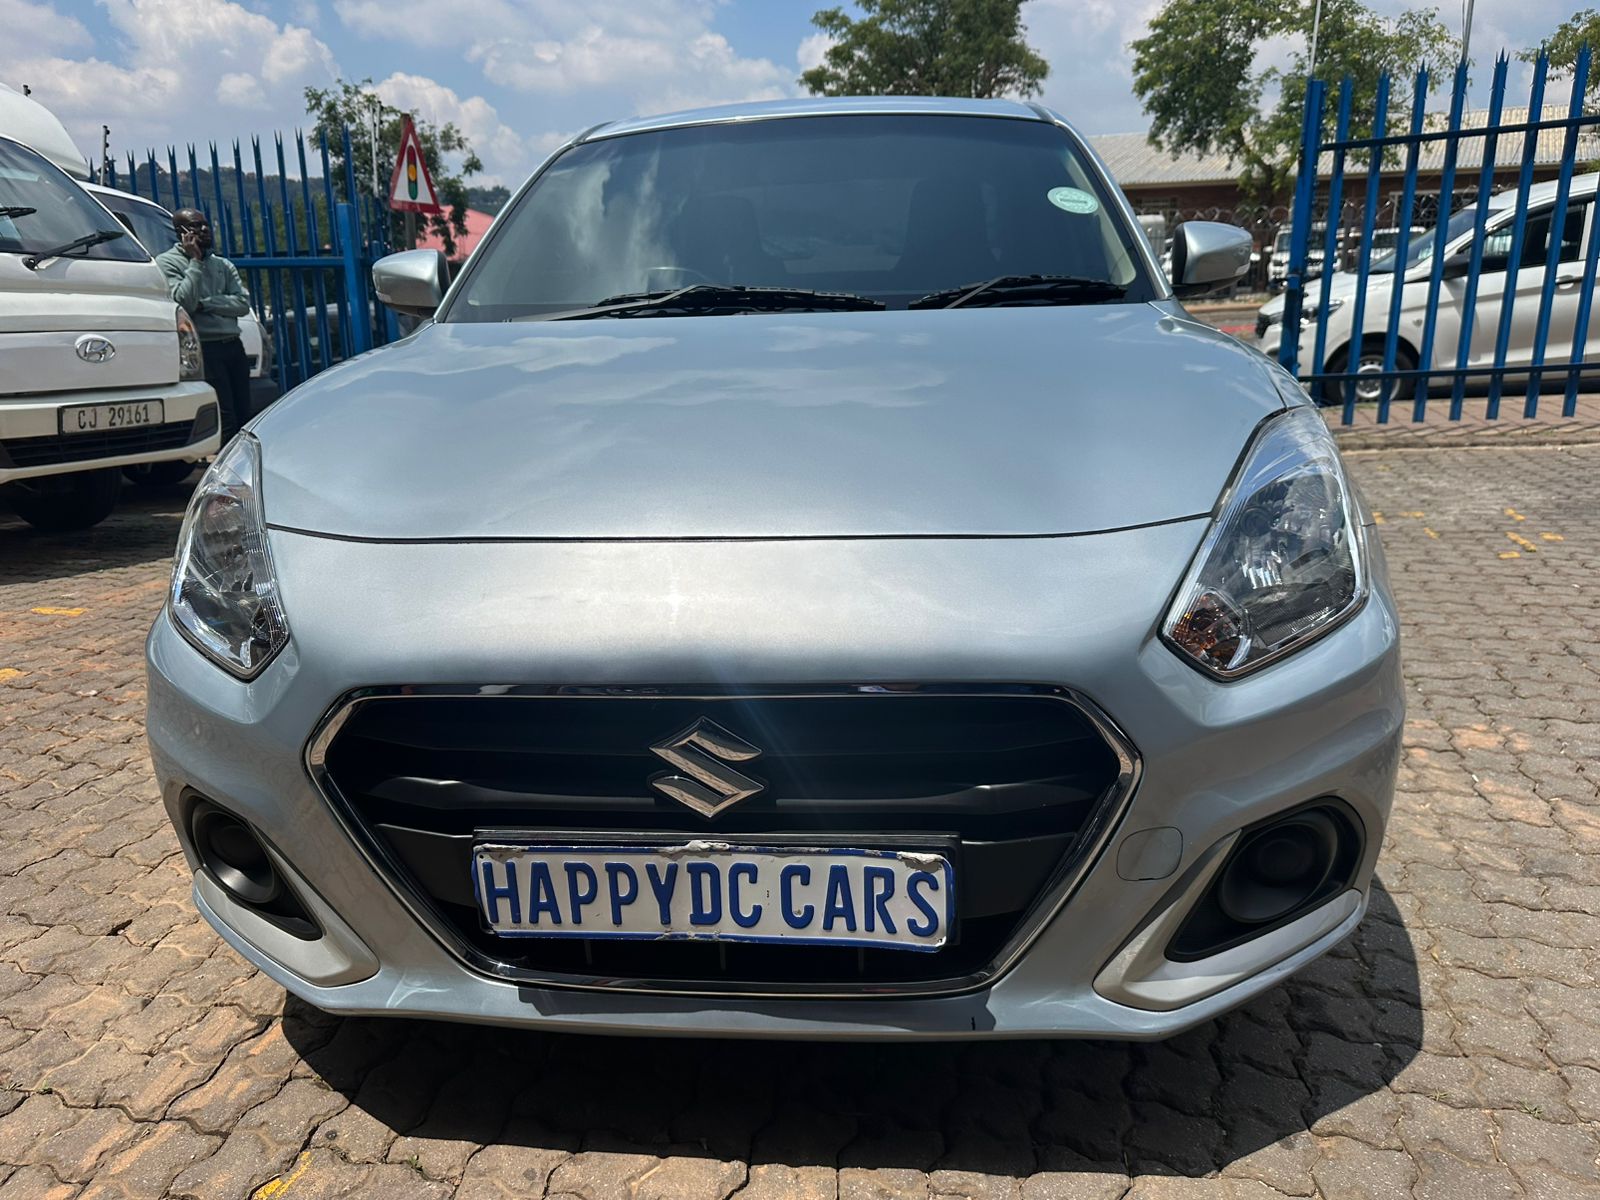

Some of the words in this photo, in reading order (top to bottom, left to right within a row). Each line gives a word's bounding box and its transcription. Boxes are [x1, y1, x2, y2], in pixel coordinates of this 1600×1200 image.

[78, 407, 97, 429] CJ
[108, 403, 150, 427] 29161
[482, 861, 762, 928] HAPPYDC
[780, 864, 939, 937] CARS
